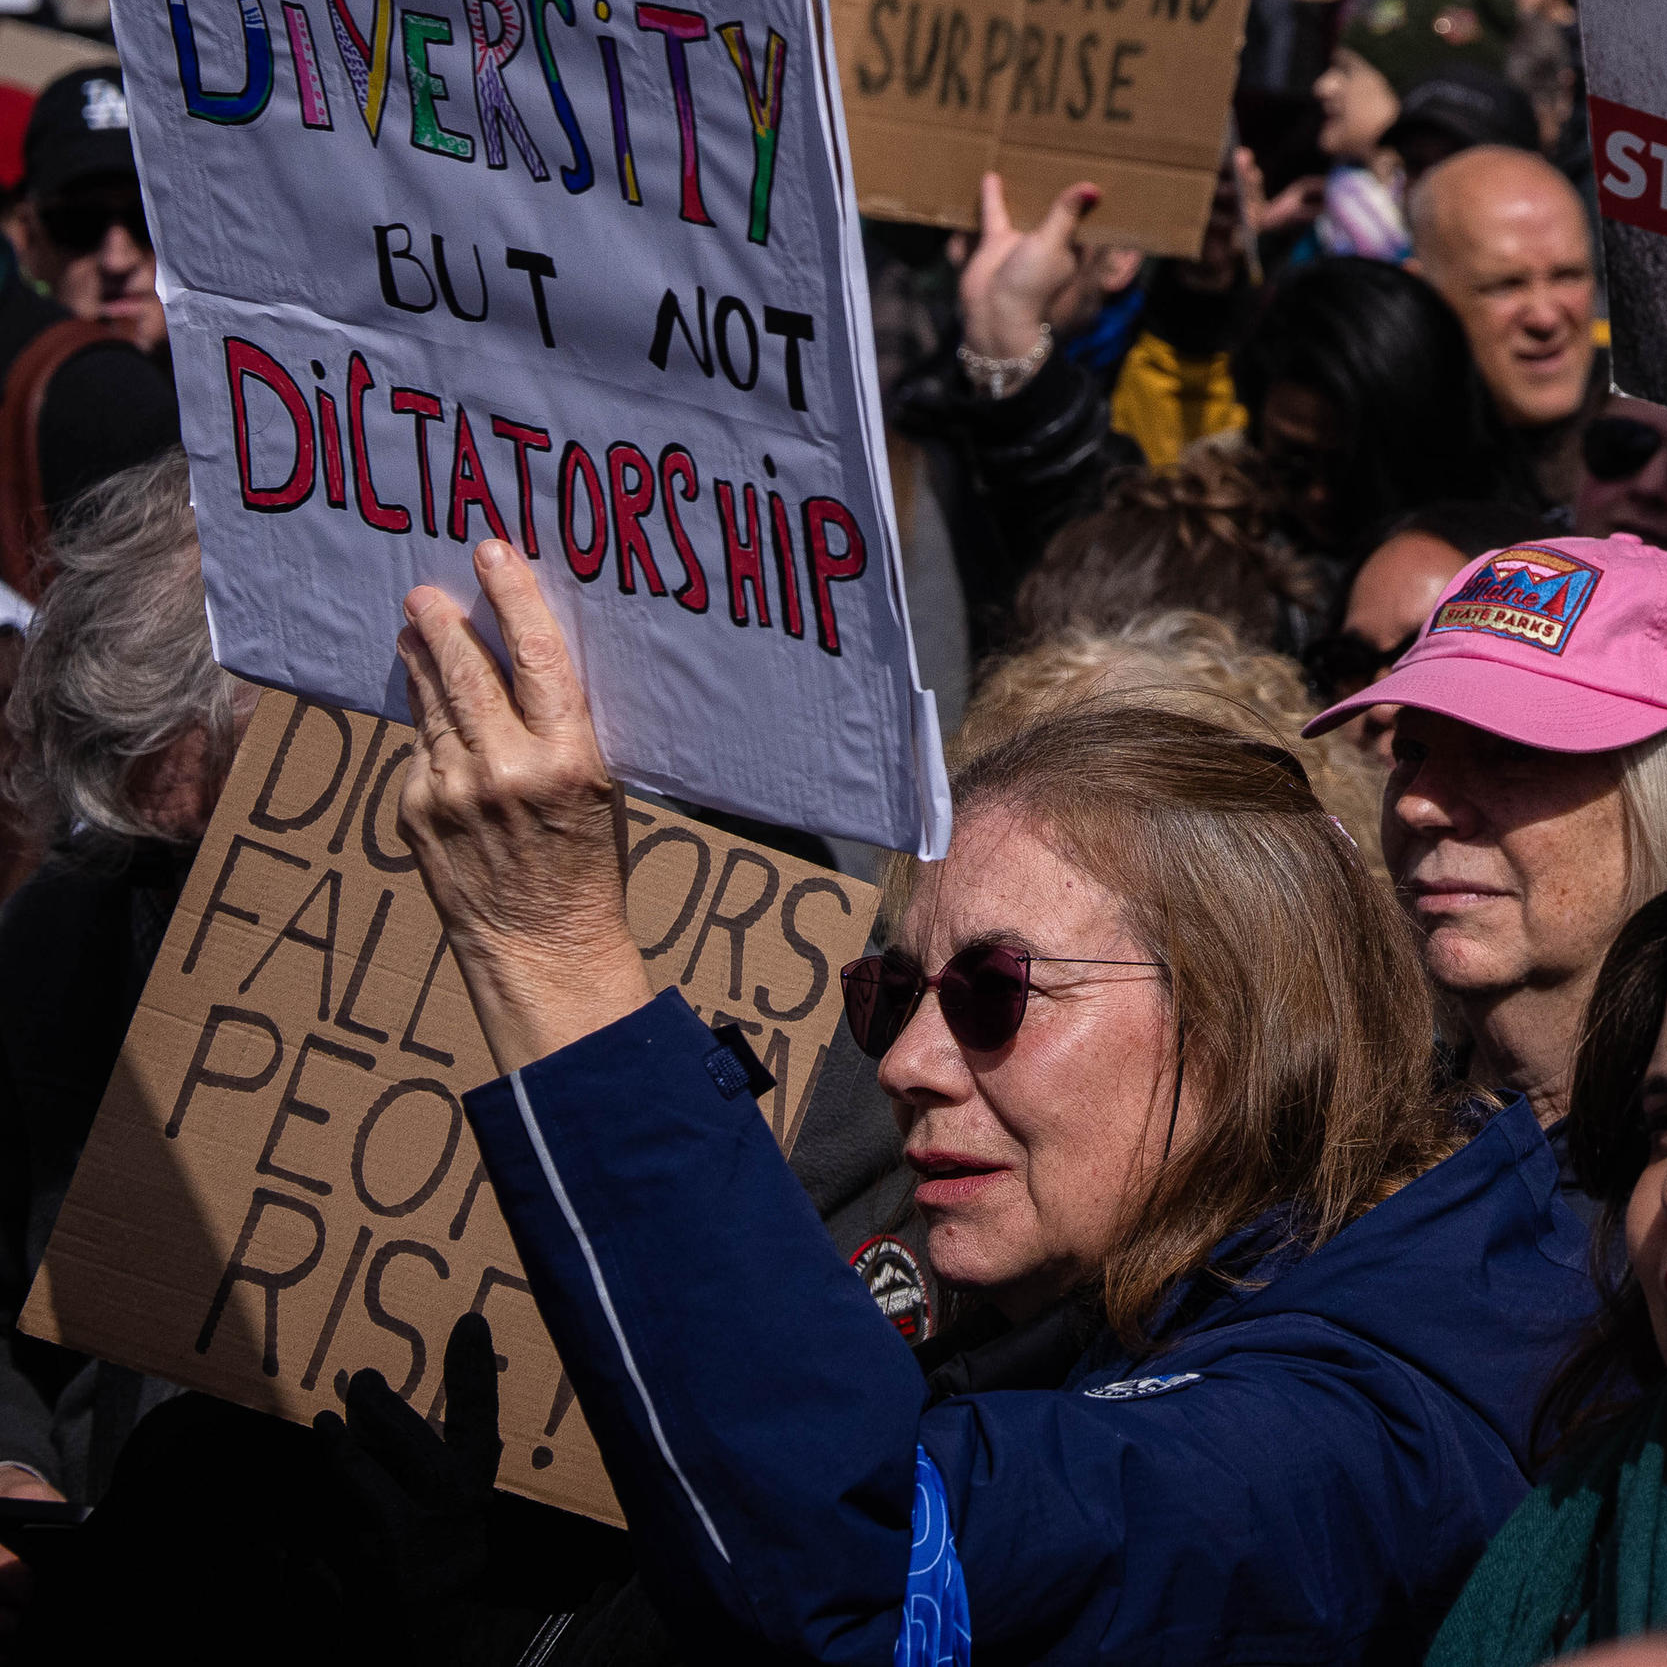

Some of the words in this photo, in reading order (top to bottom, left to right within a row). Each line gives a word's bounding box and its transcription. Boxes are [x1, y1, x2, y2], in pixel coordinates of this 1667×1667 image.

[373, 223, 558, 349] BUT
[648, 285, 815, 413] NOT
[1444, 608, 1492, 623] STATE
[1494, 609, 1556, 637] PARKS
[181, 834, 456, 1067] FALL
[250, 698, 853, 1023] DICORS
